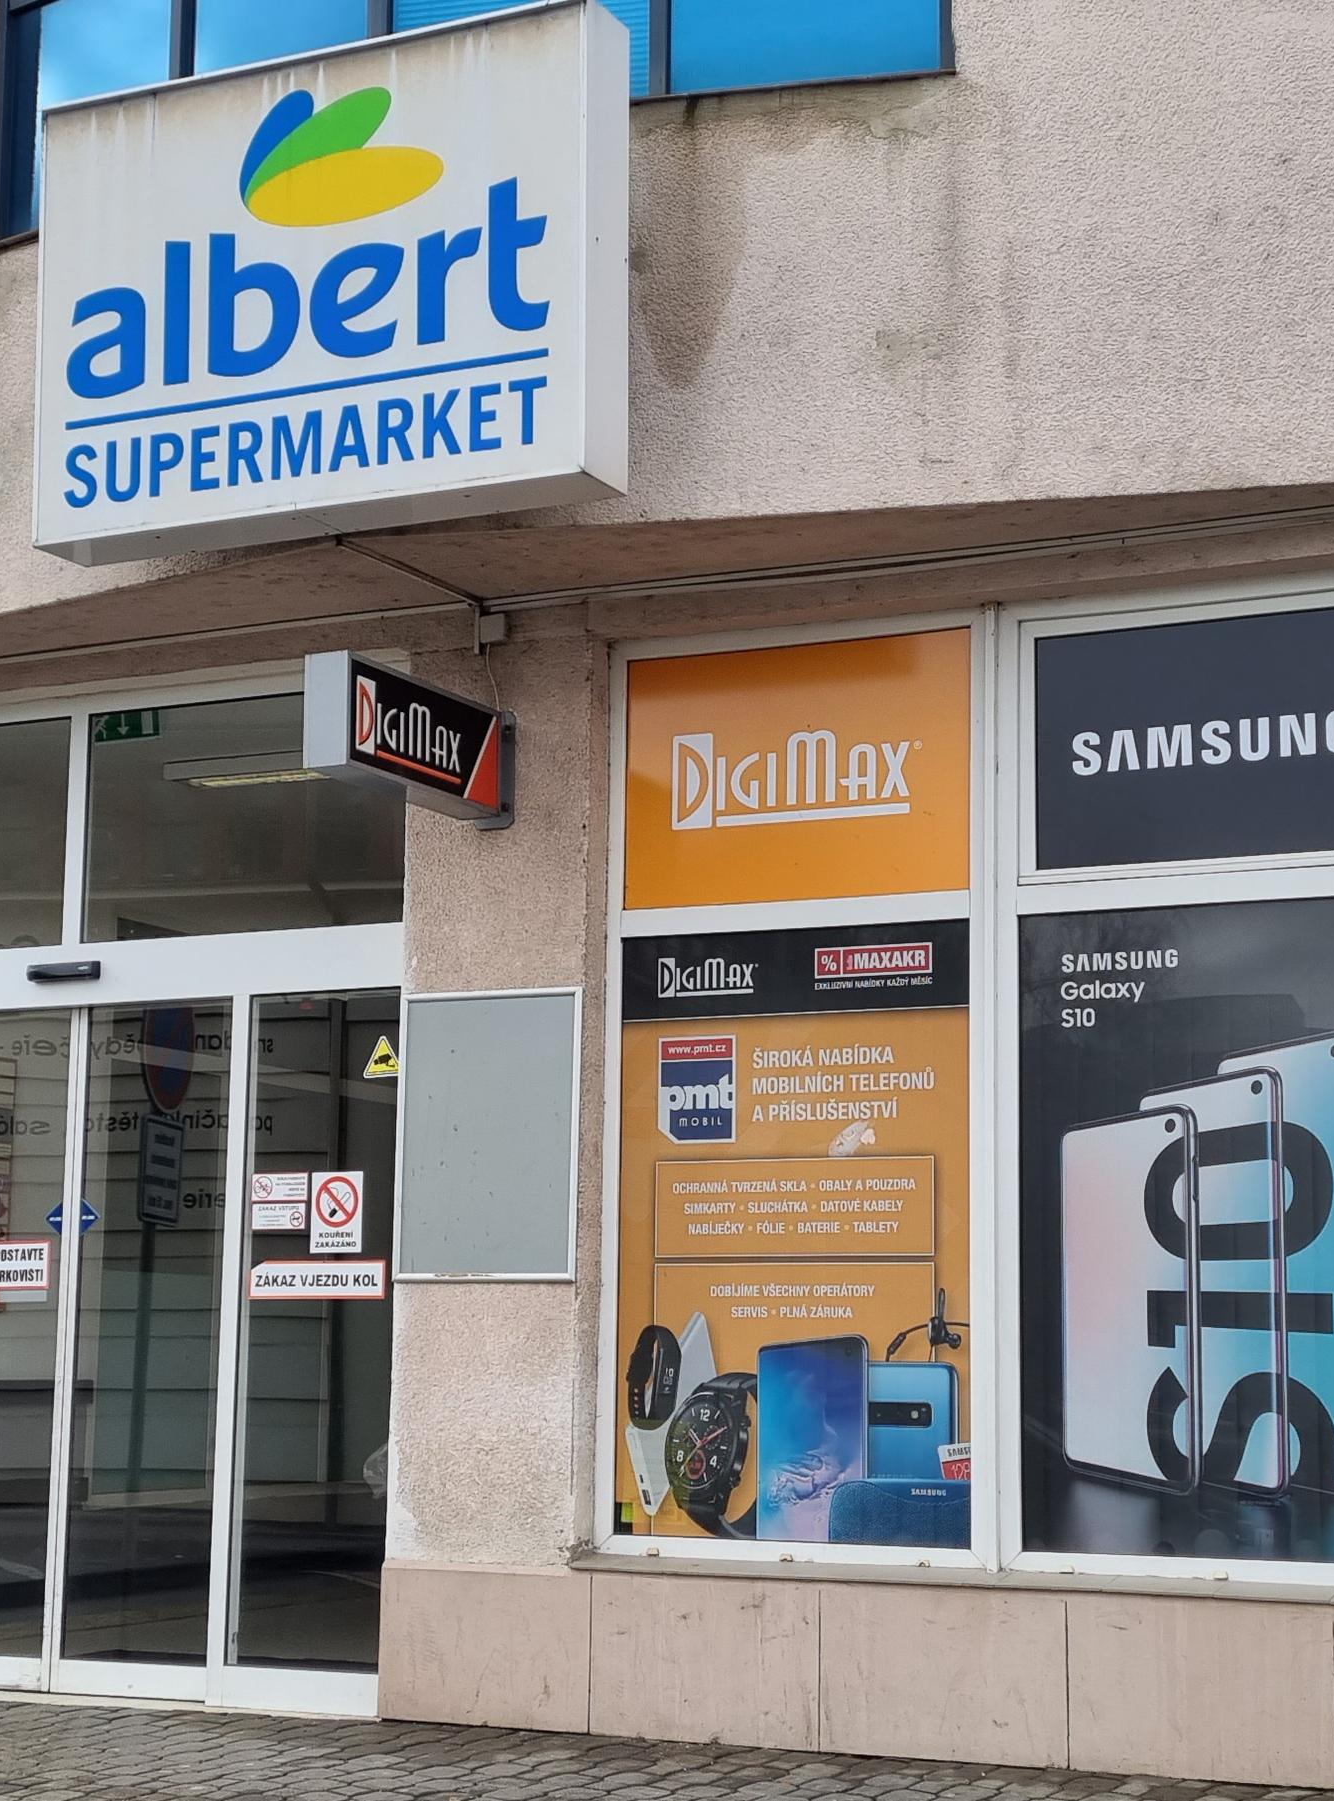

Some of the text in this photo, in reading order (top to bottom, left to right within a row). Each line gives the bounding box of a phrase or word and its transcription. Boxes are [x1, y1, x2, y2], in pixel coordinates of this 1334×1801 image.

[67, 177, 550, 399] albert
[64, 376, 547, 508] SUPERMARKET
[1061, 948, 1179, 973] SAMSUNG
[855, 979, 885, 989] NABÍDKY
[887, 977, 909, 987] KAŽDÝ
[1060, 980, 1145, 1003] Galaxy
[1060, 1007, 1096, 1028] S10
[668, 1044, 727, 1056] www.pmt.cz
[752, 1044, 895, 1069] ŠIROKÁ NABÍDKA
[752, 1066, 935, 1095] MOBILNÍCH TELEFONŮ
[658, 1074, 733, 1134] pmt
[752, 1097, 898, 1122] A PŘÍSLUŠENSTVÍ
[679, 1117, 723, 1128] MOBIL
[672, 1178, 916, 1194] OCHRANNÁ TVRZENÁ SKLA OBALY A POUZDRA
[684, 1198, 903, 1214] SIMKARTY SLUCHÁTKA DATOVÉ KABELY
[318, 1231, 354, 1239] KOUŘENÍ
[688, 1220, 899, 1235] NABÍJEČKY FÓLIE BATERIE TABLETY
[255, 1272, 378, 1287] ZÁKAZ VJEZDU KOL
[710, 1282, 875, 1297] DOBÍJÍME VŠECHNY OPERÁTORY
[731, 1304, 852, 1318] SERVIS PLNÁ ZÁRUKA
[700, 1409, 710, 1421] 12
[676, 1450, 684, 1462] 8
[710, 1455, 717, 1467] 4
[910, 1488, 947, 1496] SAMSUNG
